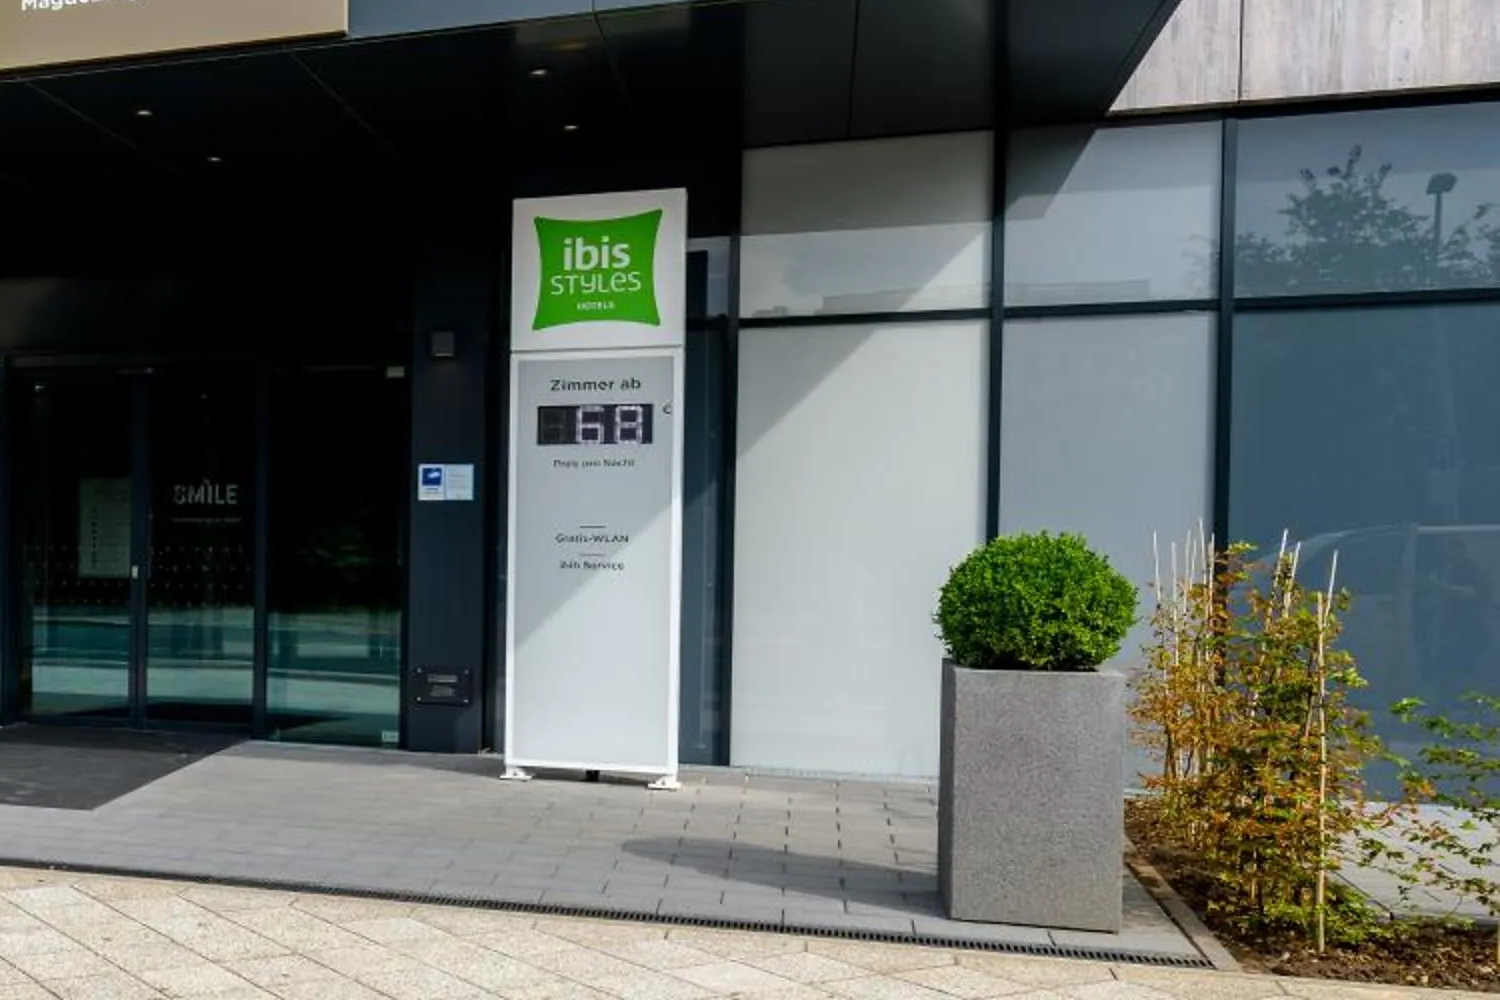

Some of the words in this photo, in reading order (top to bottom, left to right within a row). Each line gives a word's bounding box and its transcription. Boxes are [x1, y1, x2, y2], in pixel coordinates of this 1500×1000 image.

[562, 236, 631, 272] ibis
[576, 300, 616, 312] HOTELS
[550, 378, 615, 392] Zimmer
[619, 377, 642, 390] ab
[575, 404, 644, 445] 68
[172, 480, 239, 505] SMILE
